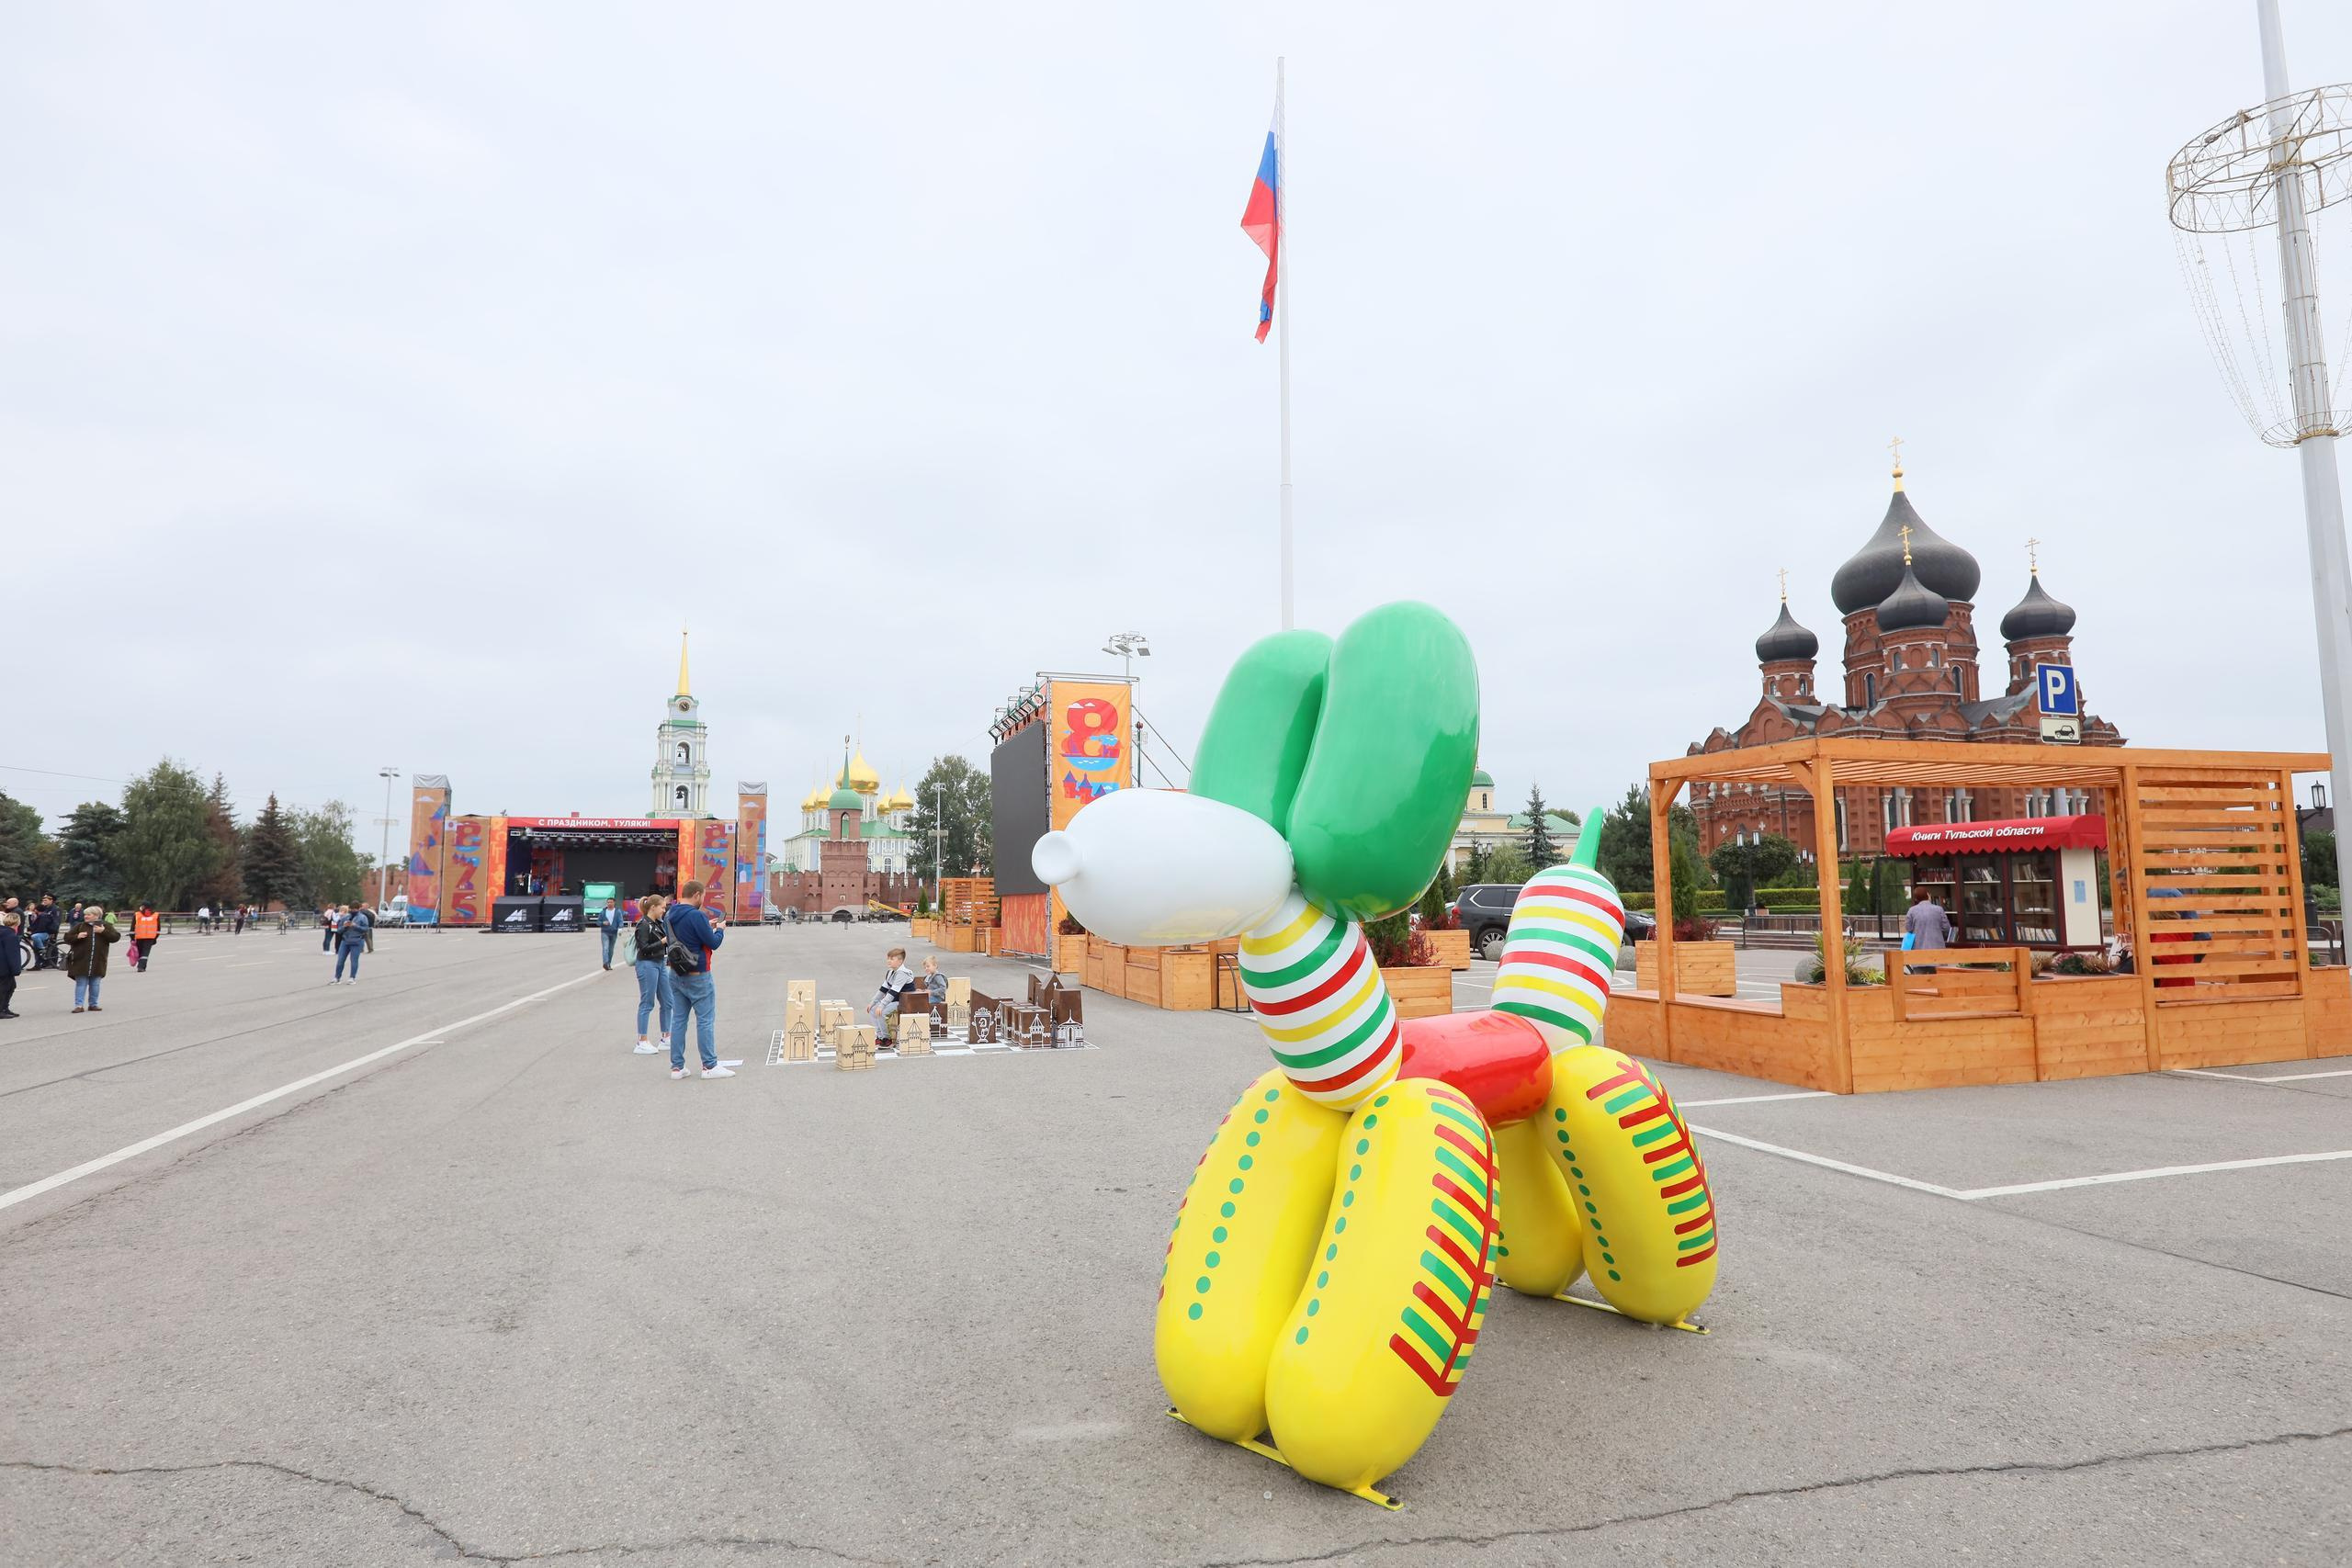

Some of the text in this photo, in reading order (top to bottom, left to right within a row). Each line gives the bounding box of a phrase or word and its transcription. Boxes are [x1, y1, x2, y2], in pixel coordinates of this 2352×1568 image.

[2046, 669, 2066, 709] P
[1911, 826, 2045, 841] Книги Тульской области
